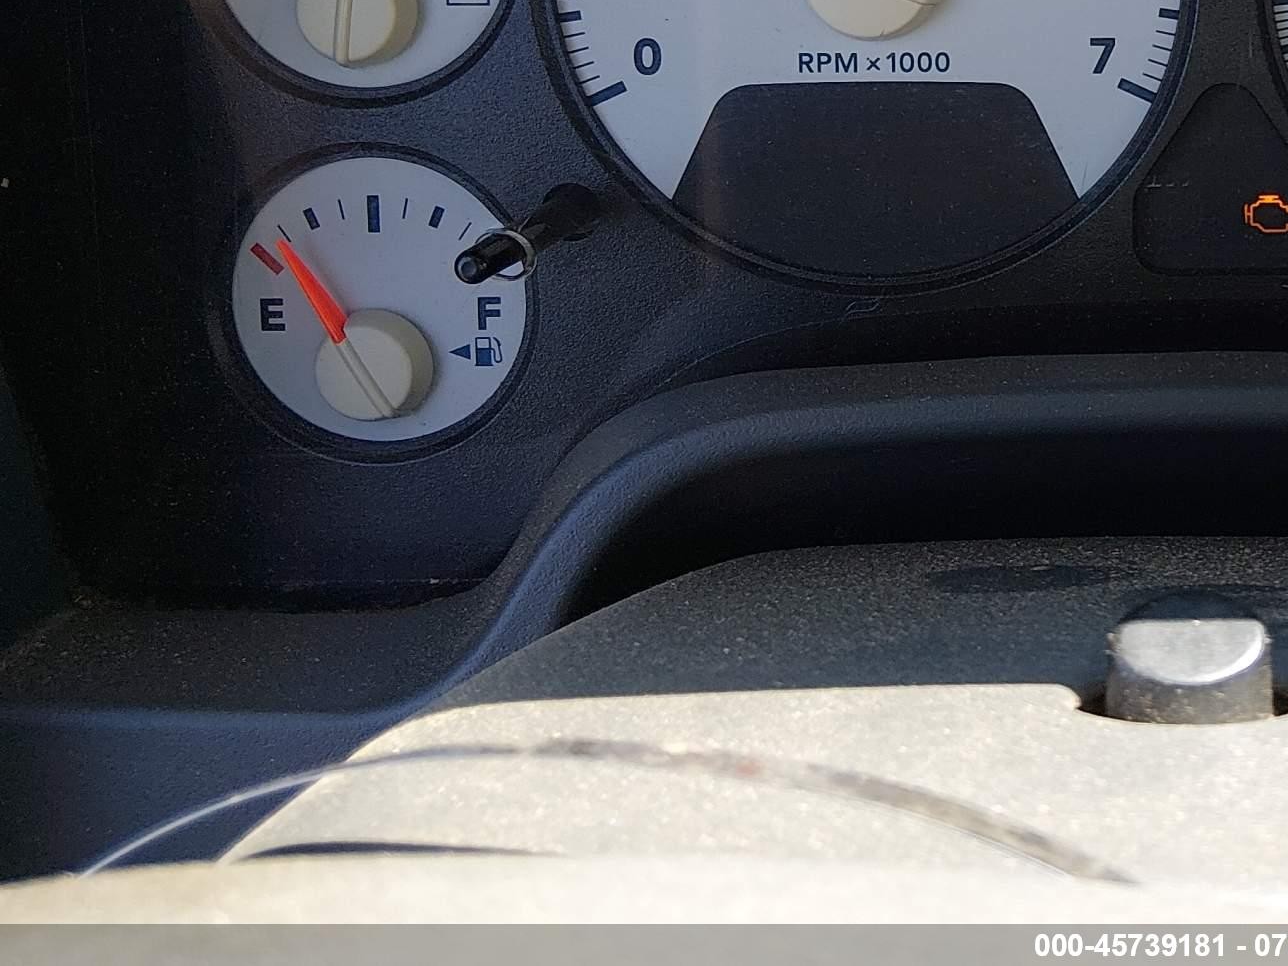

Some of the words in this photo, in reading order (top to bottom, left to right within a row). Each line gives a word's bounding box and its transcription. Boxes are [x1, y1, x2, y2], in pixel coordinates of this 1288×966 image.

[634, 38, 661, 75] 0
[799, 53, 857, 73] RPM
[1090, 38, 1115, 74] 7
[260, 298, 285, 331] E
[478, 297, 501, 330] F
